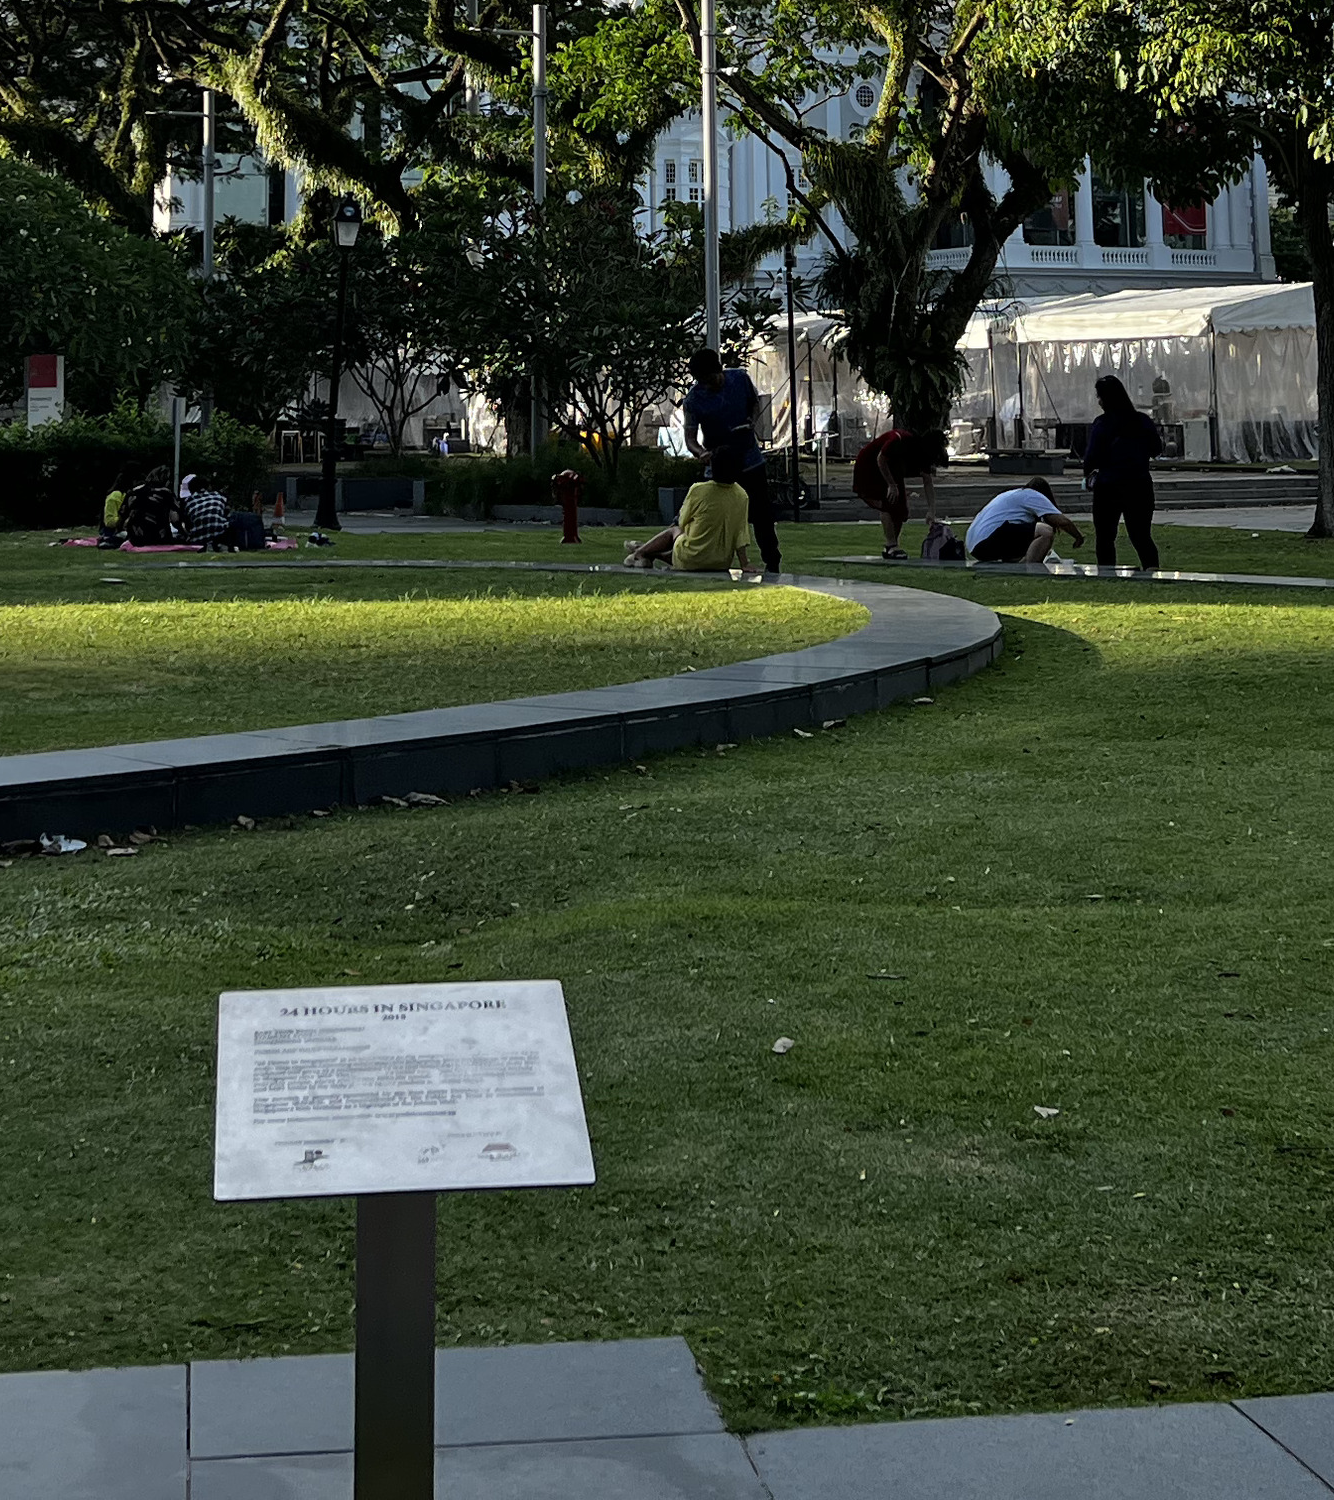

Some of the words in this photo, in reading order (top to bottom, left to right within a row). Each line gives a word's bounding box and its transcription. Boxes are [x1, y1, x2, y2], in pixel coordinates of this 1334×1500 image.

[280, 1008, 299, 1017] 24
[303, 1005, 369, 1016] HOURS
[373, 1003, 394, 1013] IN
[398, 1000, 507, 1012] SINGAPORE
